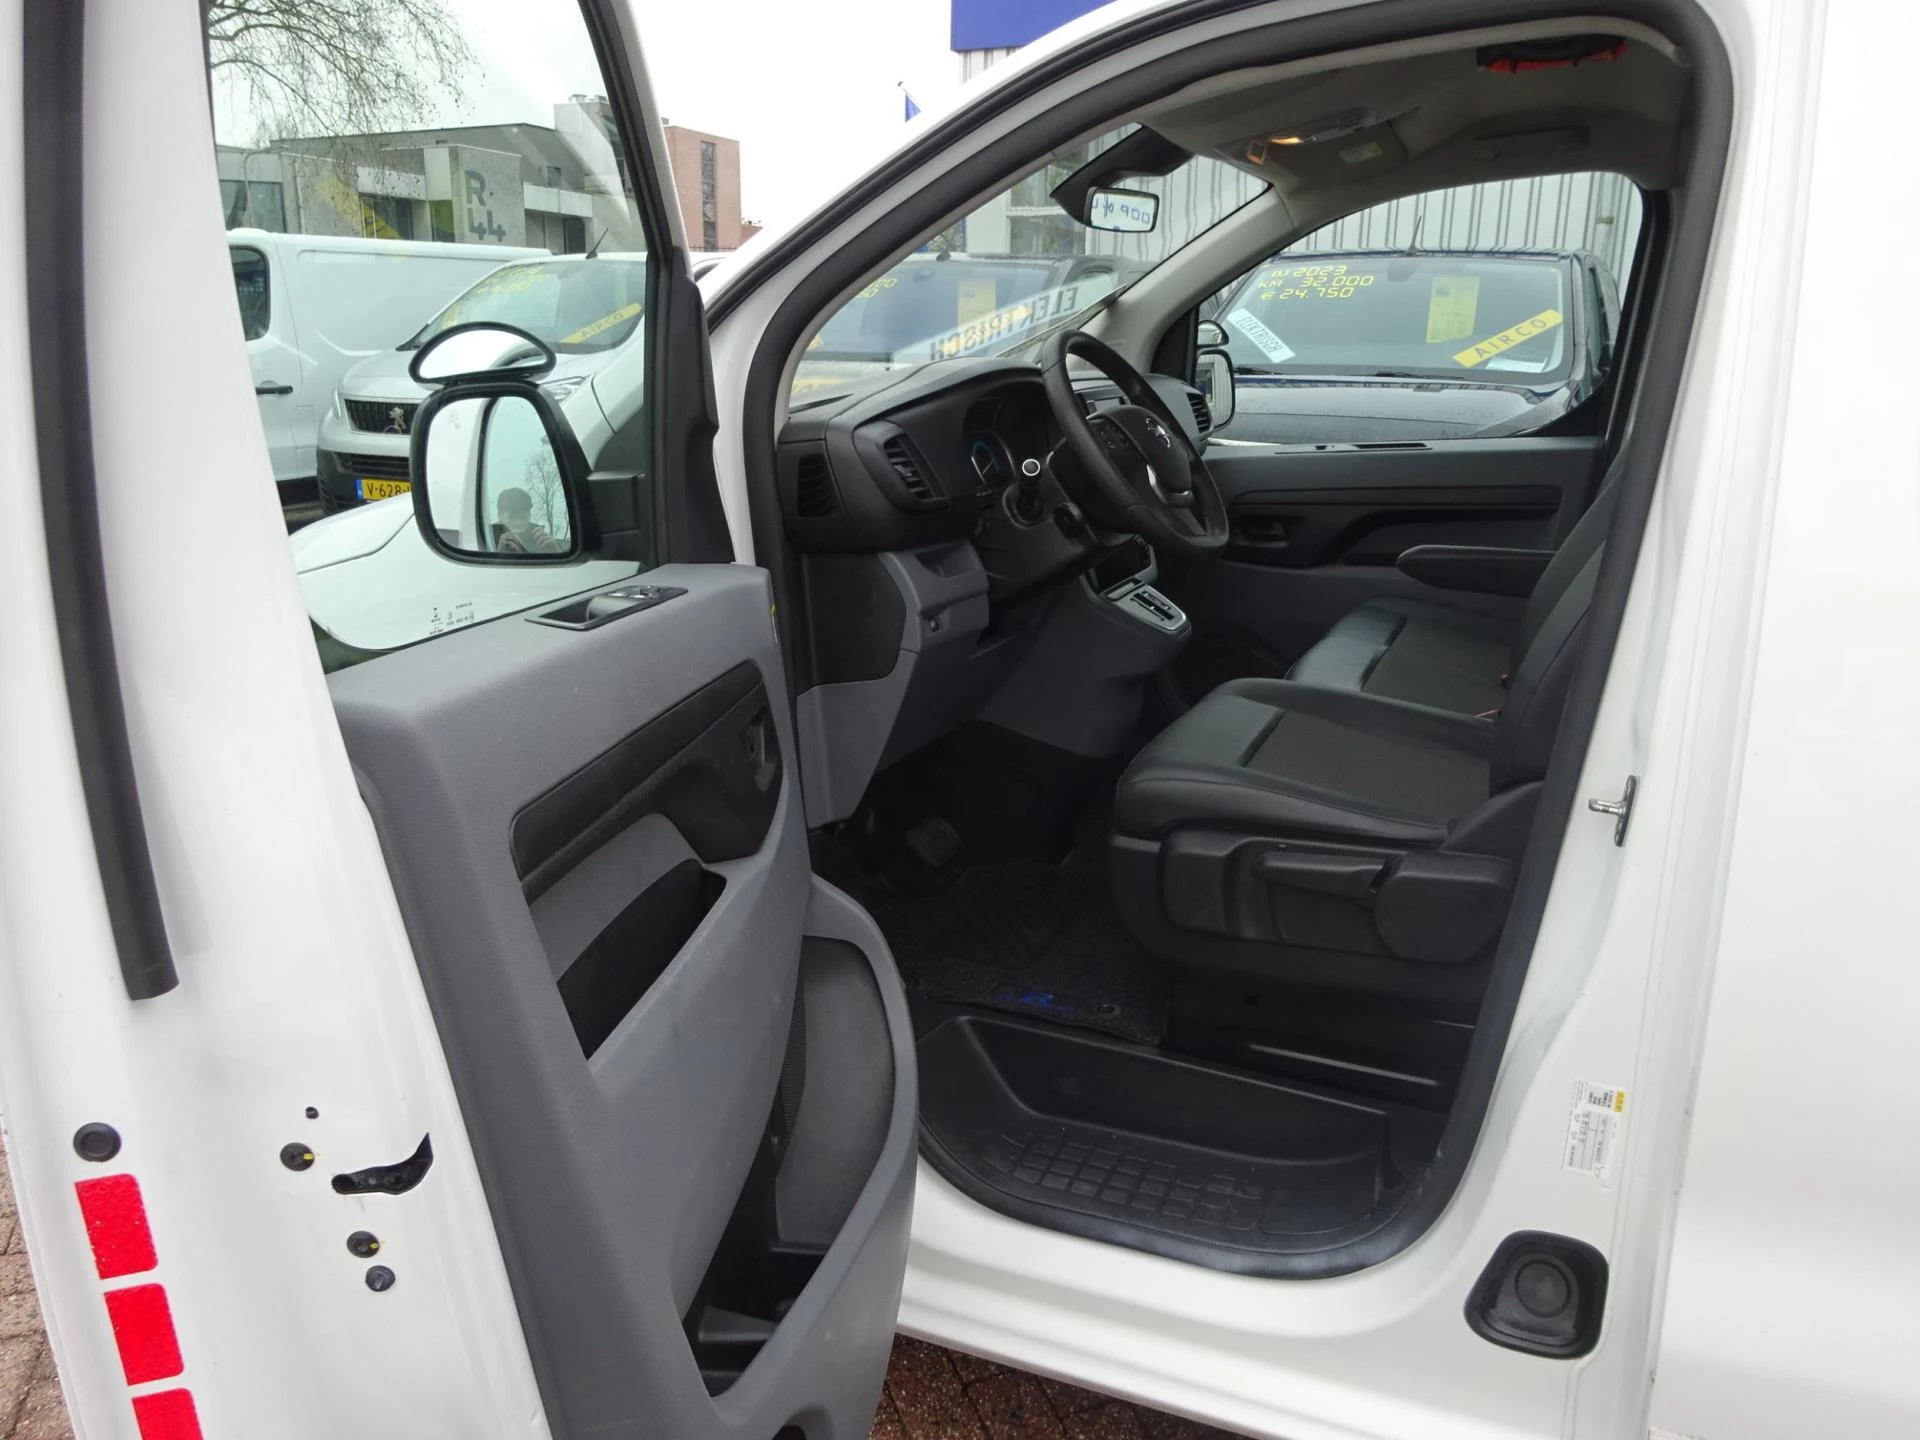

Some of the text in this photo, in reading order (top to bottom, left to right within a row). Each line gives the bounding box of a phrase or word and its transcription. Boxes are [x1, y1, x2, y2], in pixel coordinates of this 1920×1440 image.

[467, 207, 507, 243] 44
[1293, 265, 1348, 278] 2023
[1258, 275, 1376, 289] KM 32.000
[1260, 290, 1277, 301] €
[1474, 318, 1547, 359] AIRCO
